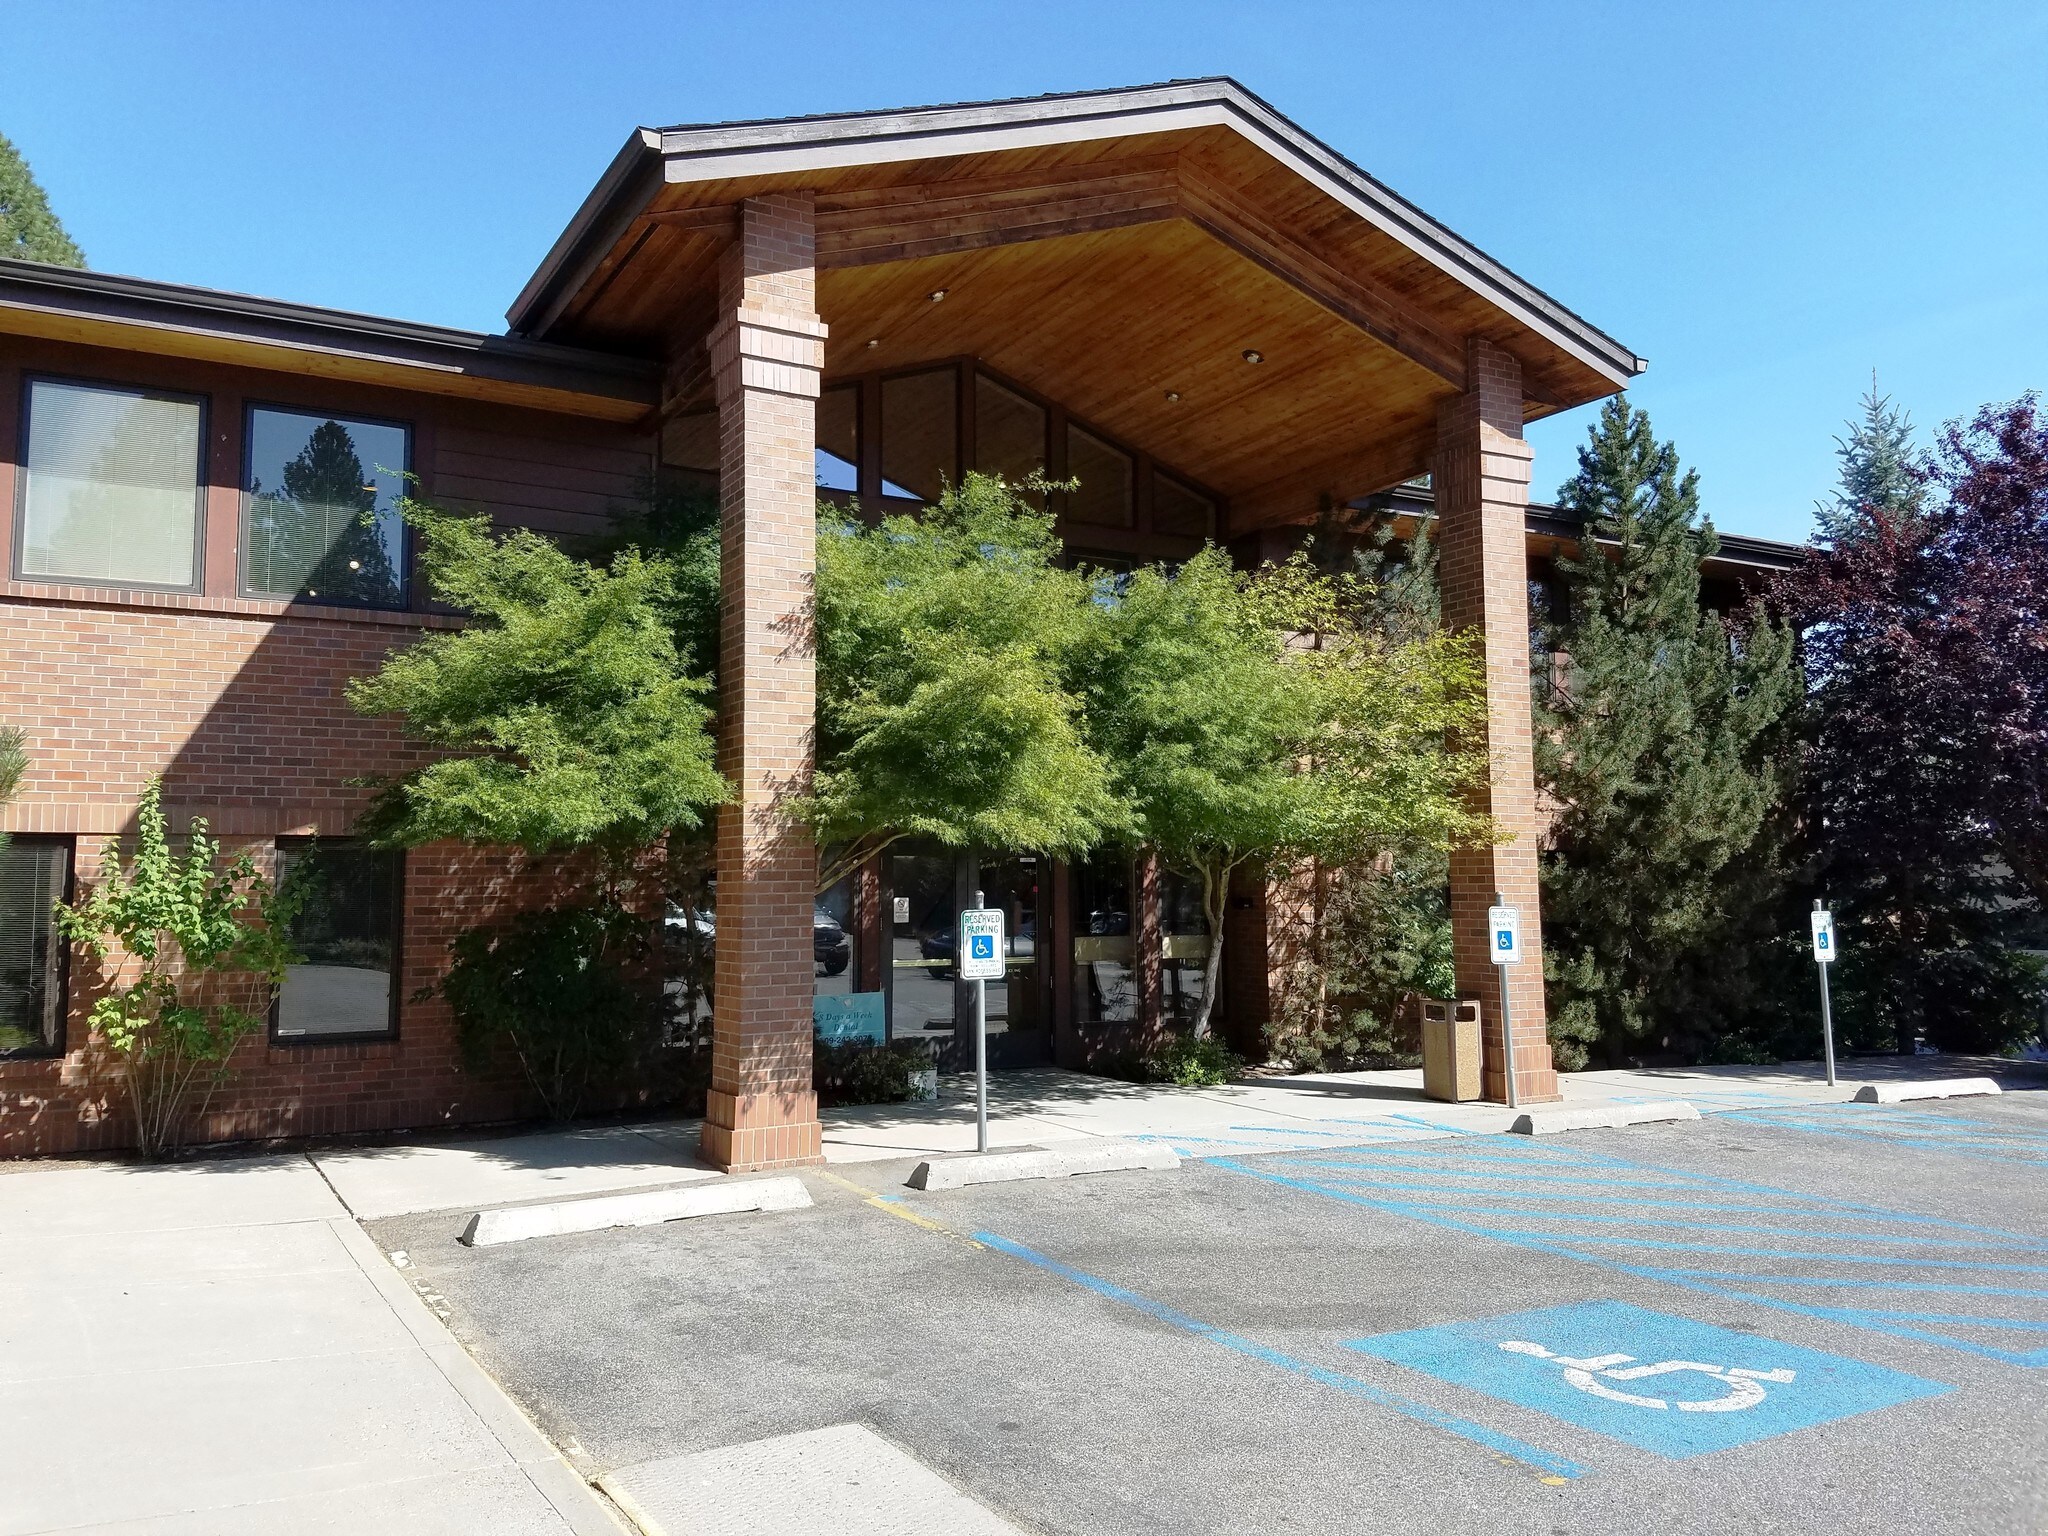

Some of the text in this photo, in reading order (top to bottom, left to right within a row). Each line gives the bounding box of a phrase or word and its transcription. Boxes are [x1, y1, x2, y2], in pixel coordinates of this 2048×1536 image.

[964, 914, 1000, 924] RESERVED
[966, 924, 999, 934] PARKING
[826, 1013, 844, 1022] Days
[853, 1011, 873, 1019] Week
[834, 1023, 859, 1031] Dental
